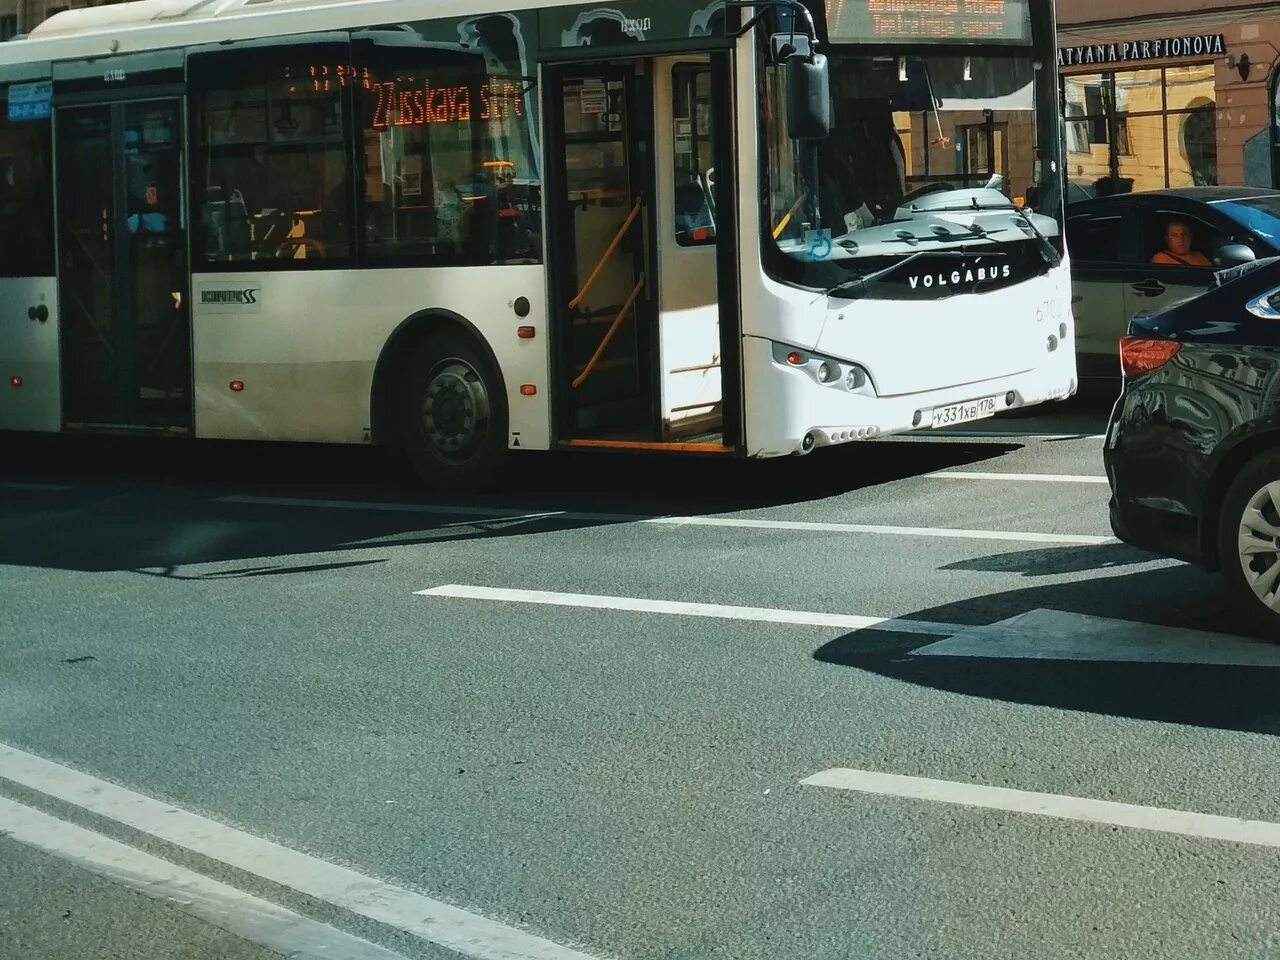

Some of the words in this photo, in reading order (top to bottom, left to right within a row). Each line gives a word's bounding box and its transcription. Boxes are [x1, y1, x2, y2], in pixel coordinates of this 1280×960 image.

[1123, 35, 1223, 60] PARFIONOVA
[908, 264, 1010, 289] VOLGABUS
[978, 398, 994, 411] 178
